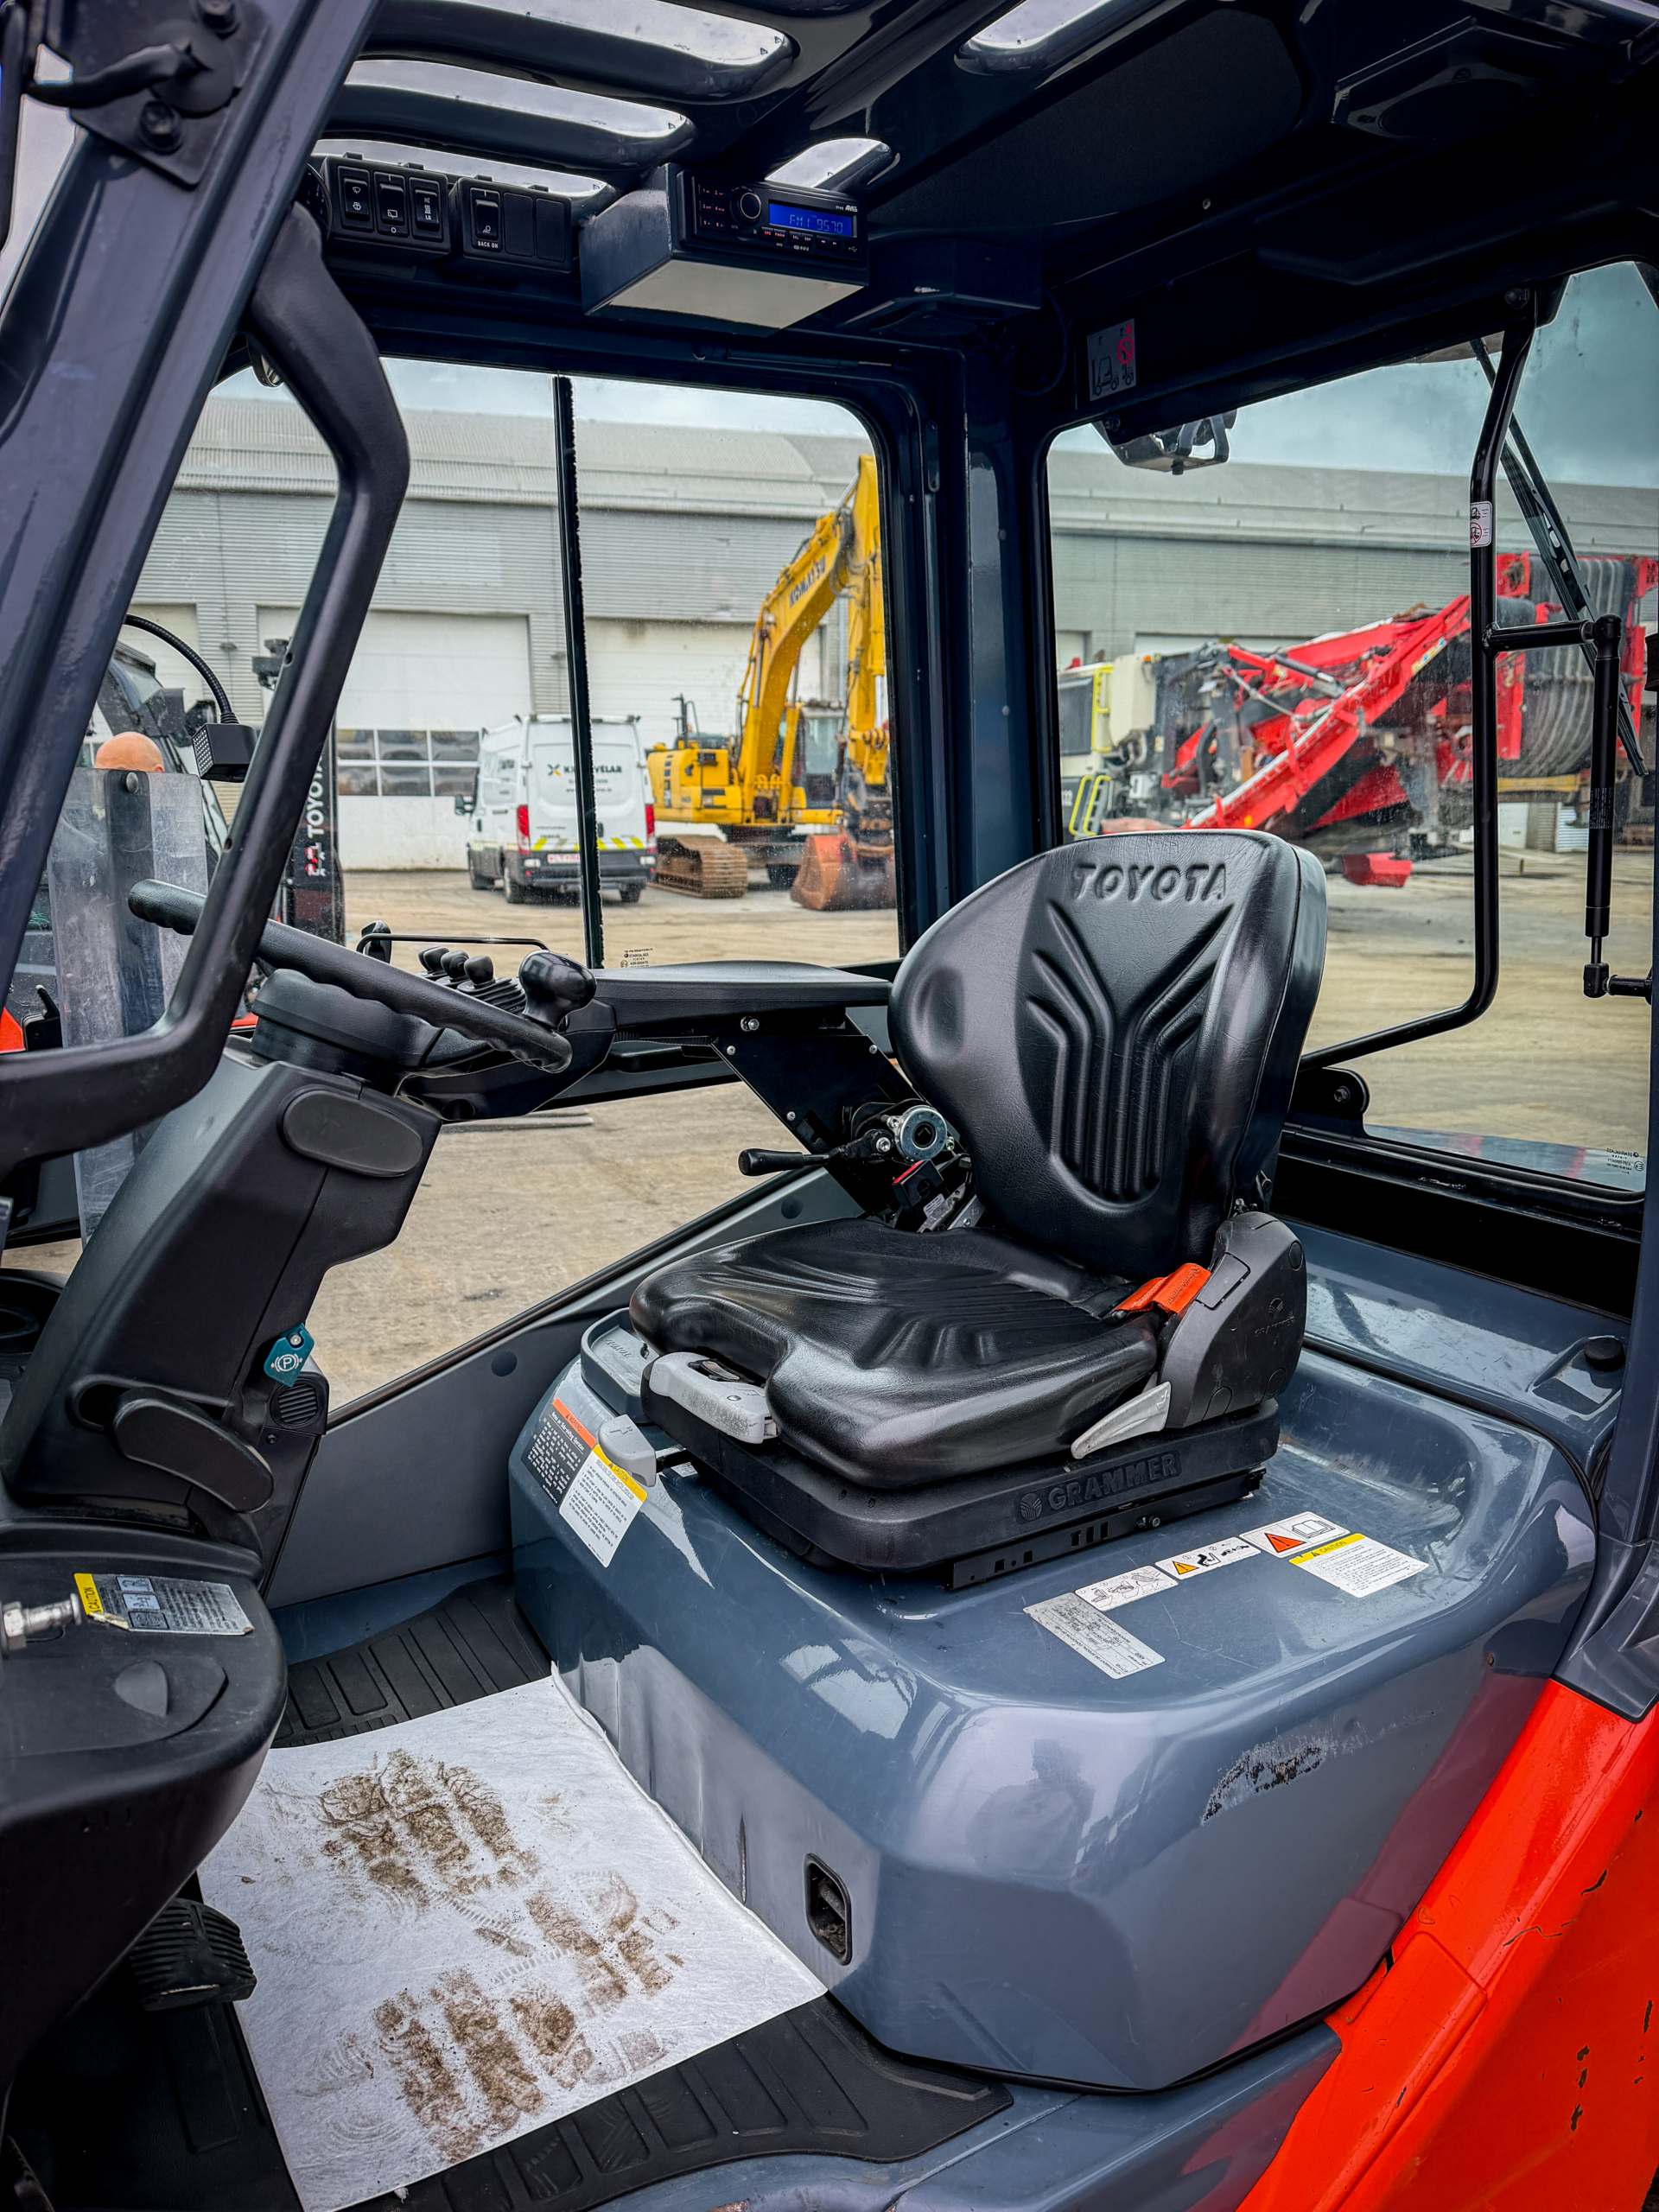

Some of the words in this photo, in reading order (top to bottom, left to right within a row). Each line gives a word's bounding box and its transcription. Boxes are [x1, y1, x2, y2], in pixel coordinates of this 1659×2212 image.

[1073, 862, 1227, 901] TOYOTA
[613, 1465, 629, 1482] CAUTION
[1047, 1452, 1179, 1511] GRAMMER
[1319, 1540, 1347, 1554] CAUTION
[83, 1586, 101, 1611] CAUTION
